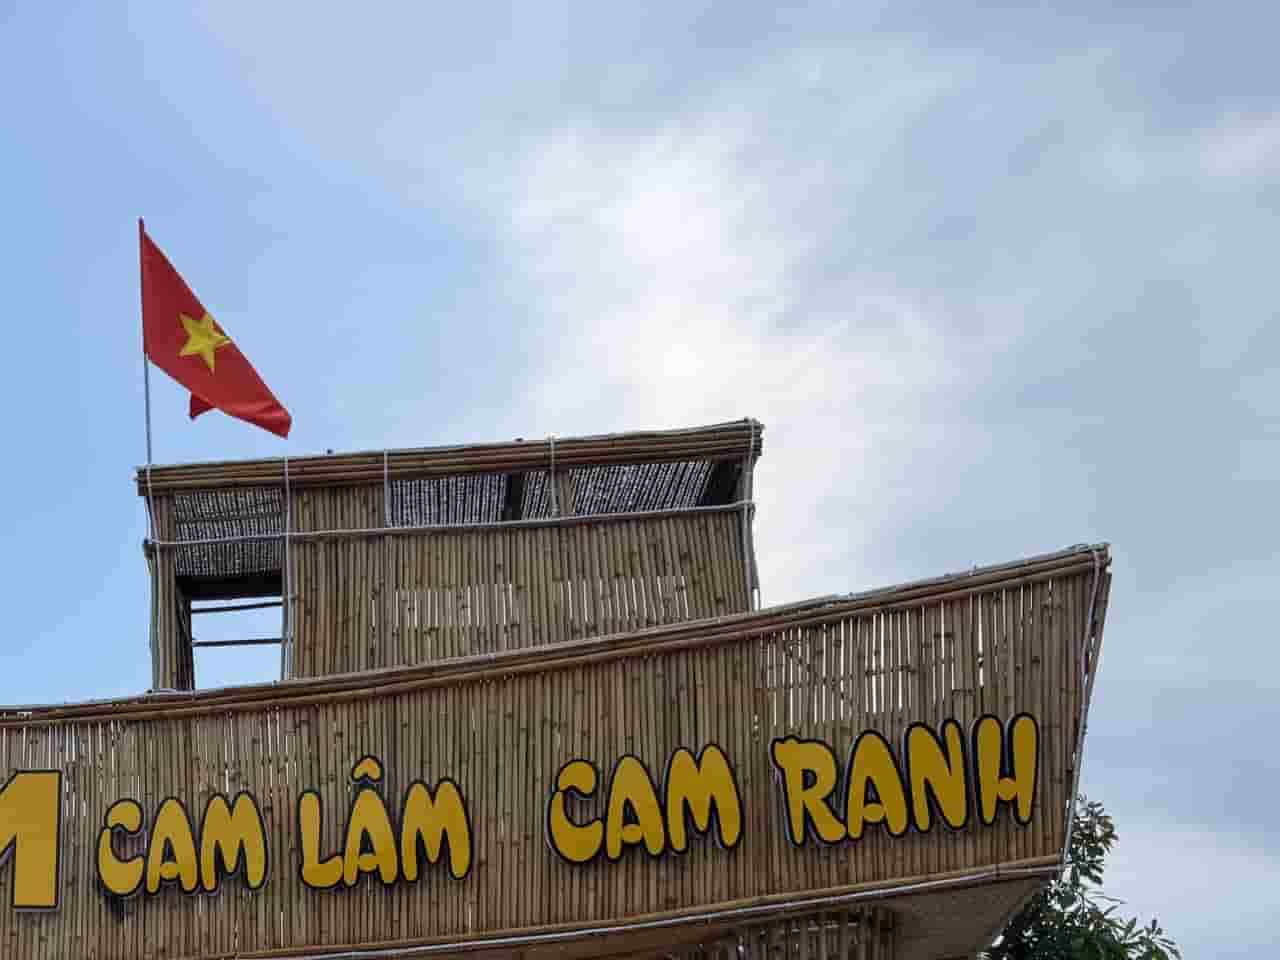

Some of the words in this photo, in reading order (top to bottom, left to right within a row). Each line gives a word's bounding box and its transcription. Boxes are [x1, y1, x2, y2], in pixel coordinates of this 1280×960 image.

[98, 789, 268, 896] CAM
[296, 754, 471, 889] LÂM
[547, 743, 744, 863] CAM
[770, 712, 1039, 846] RANH
